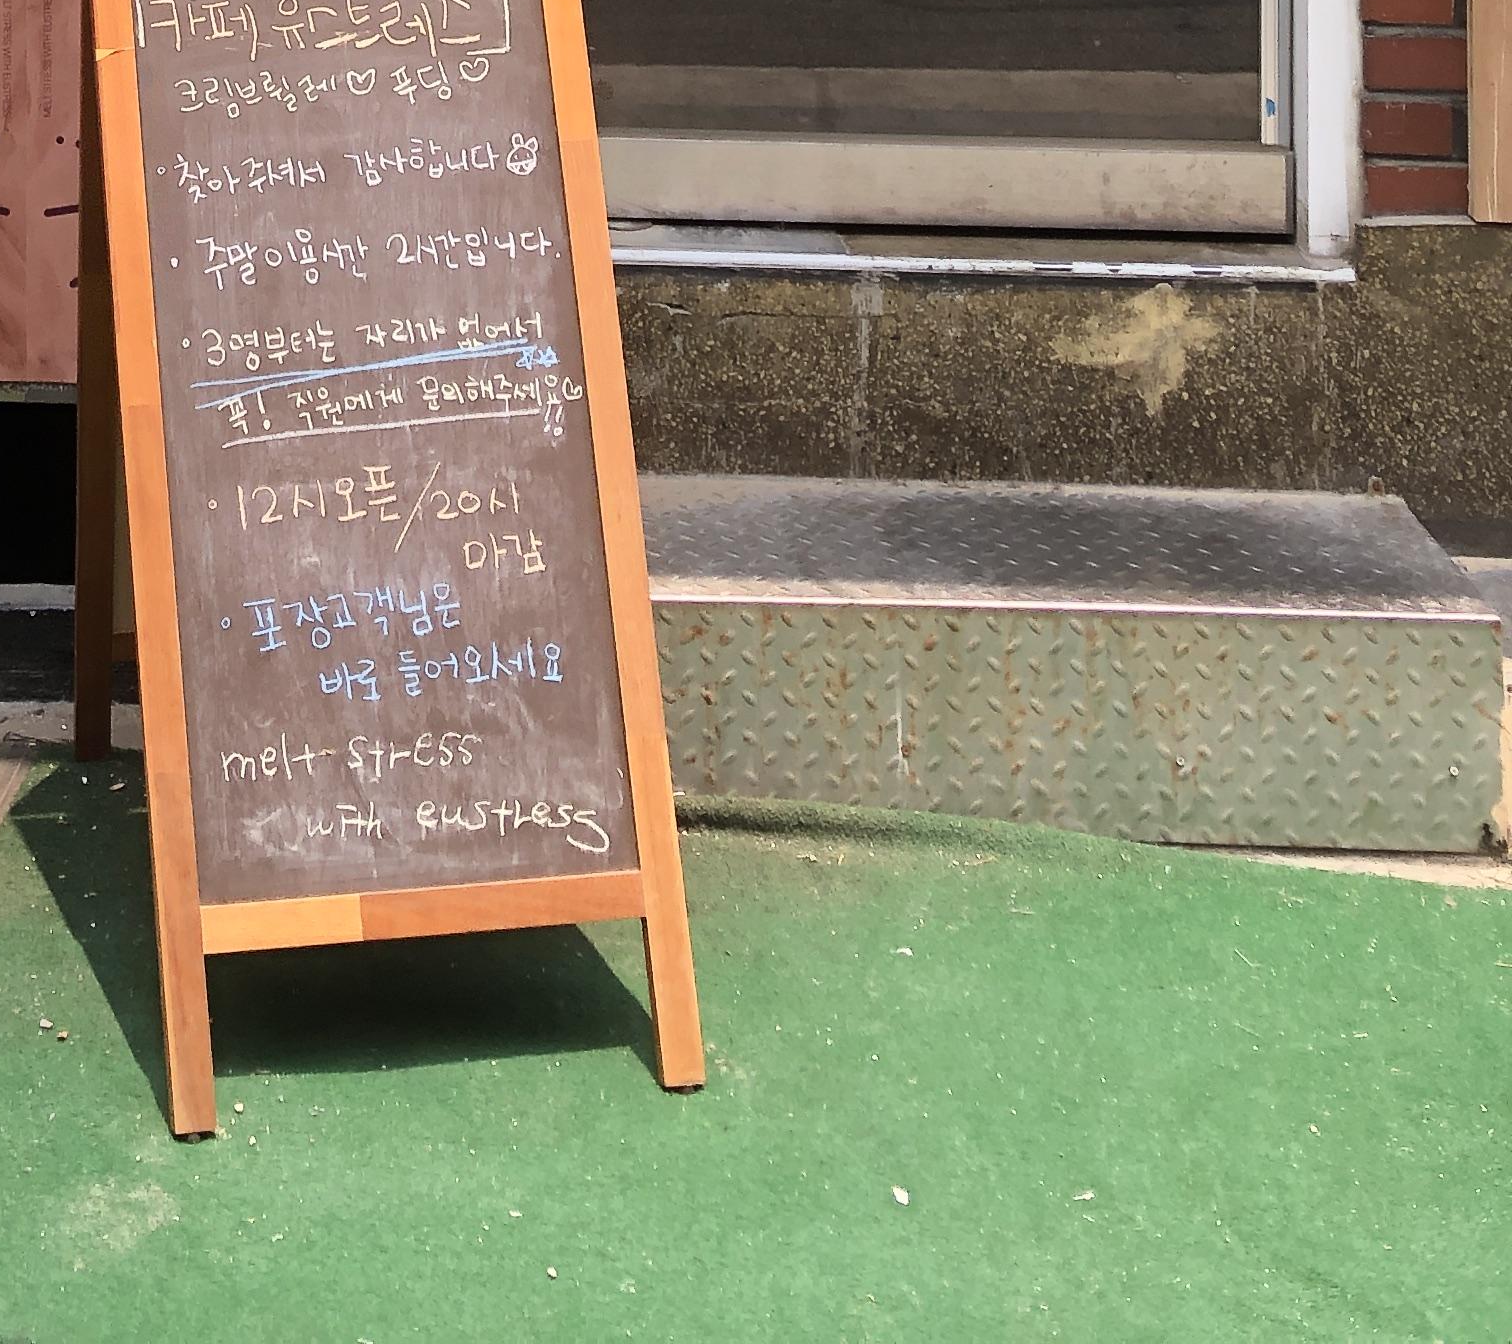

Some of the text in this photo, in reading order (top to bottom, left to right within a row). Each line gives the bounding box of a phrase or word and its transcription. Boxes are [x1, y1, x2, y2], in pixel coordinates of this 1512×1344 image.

[390, 61, 452, 106] 푸딩
[343, 139, 501, 187] 감사합니다
[356, 321, 448, 349] 자리가
[287, 385, 404, 430] 직원에게
[463, 531, 546, 574] 마감
[320, 643, 564, 702] 바로 들어오세요
